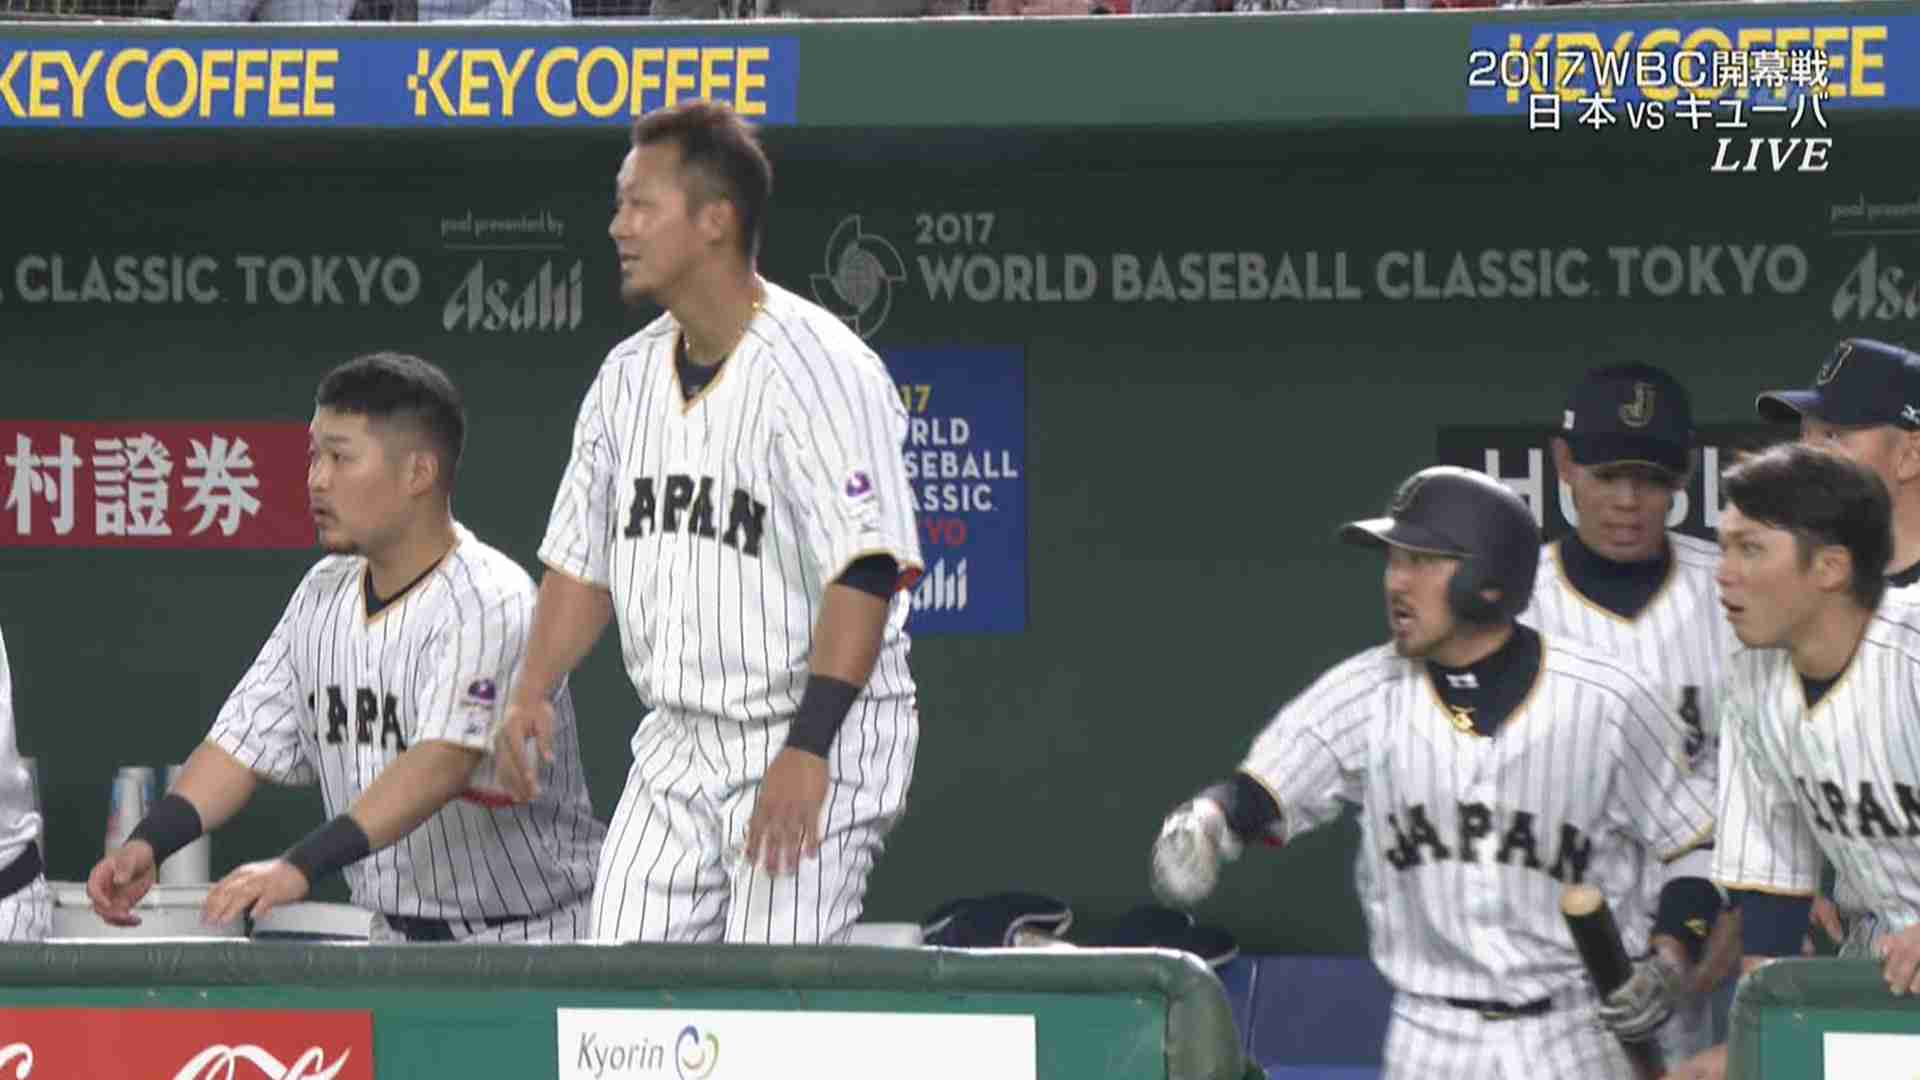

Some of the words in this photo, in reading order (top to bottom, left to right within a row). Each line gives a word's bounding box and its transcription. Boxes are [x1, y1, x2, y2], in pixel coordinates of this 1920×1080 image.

[915, 212, 995, 245] 2017
[15, 254, 220, 303] CLASSIC
[235, 253, 421, 306] TOKYO
[441, 257, 583, 333] Asahi
[917, 253, 1098, 303] WORLD
[1110, 250, 1362, 303] BASEBALL
[1376, 248, 1592, 300] CLASSIC
[1607, 243, 1808, 298] TOKYO
[900, 384, 931, 413] 17
[911, 417, 970, 446] RLD
[4, 431, 262, 537] 村證券
[903, 450, 1019, 479] SEBALL
[623, 473, 767, 559] APAN
[1386, 801, 1592, 884] JAPAN
[576, 1031, 666, 1079] Kyorin
